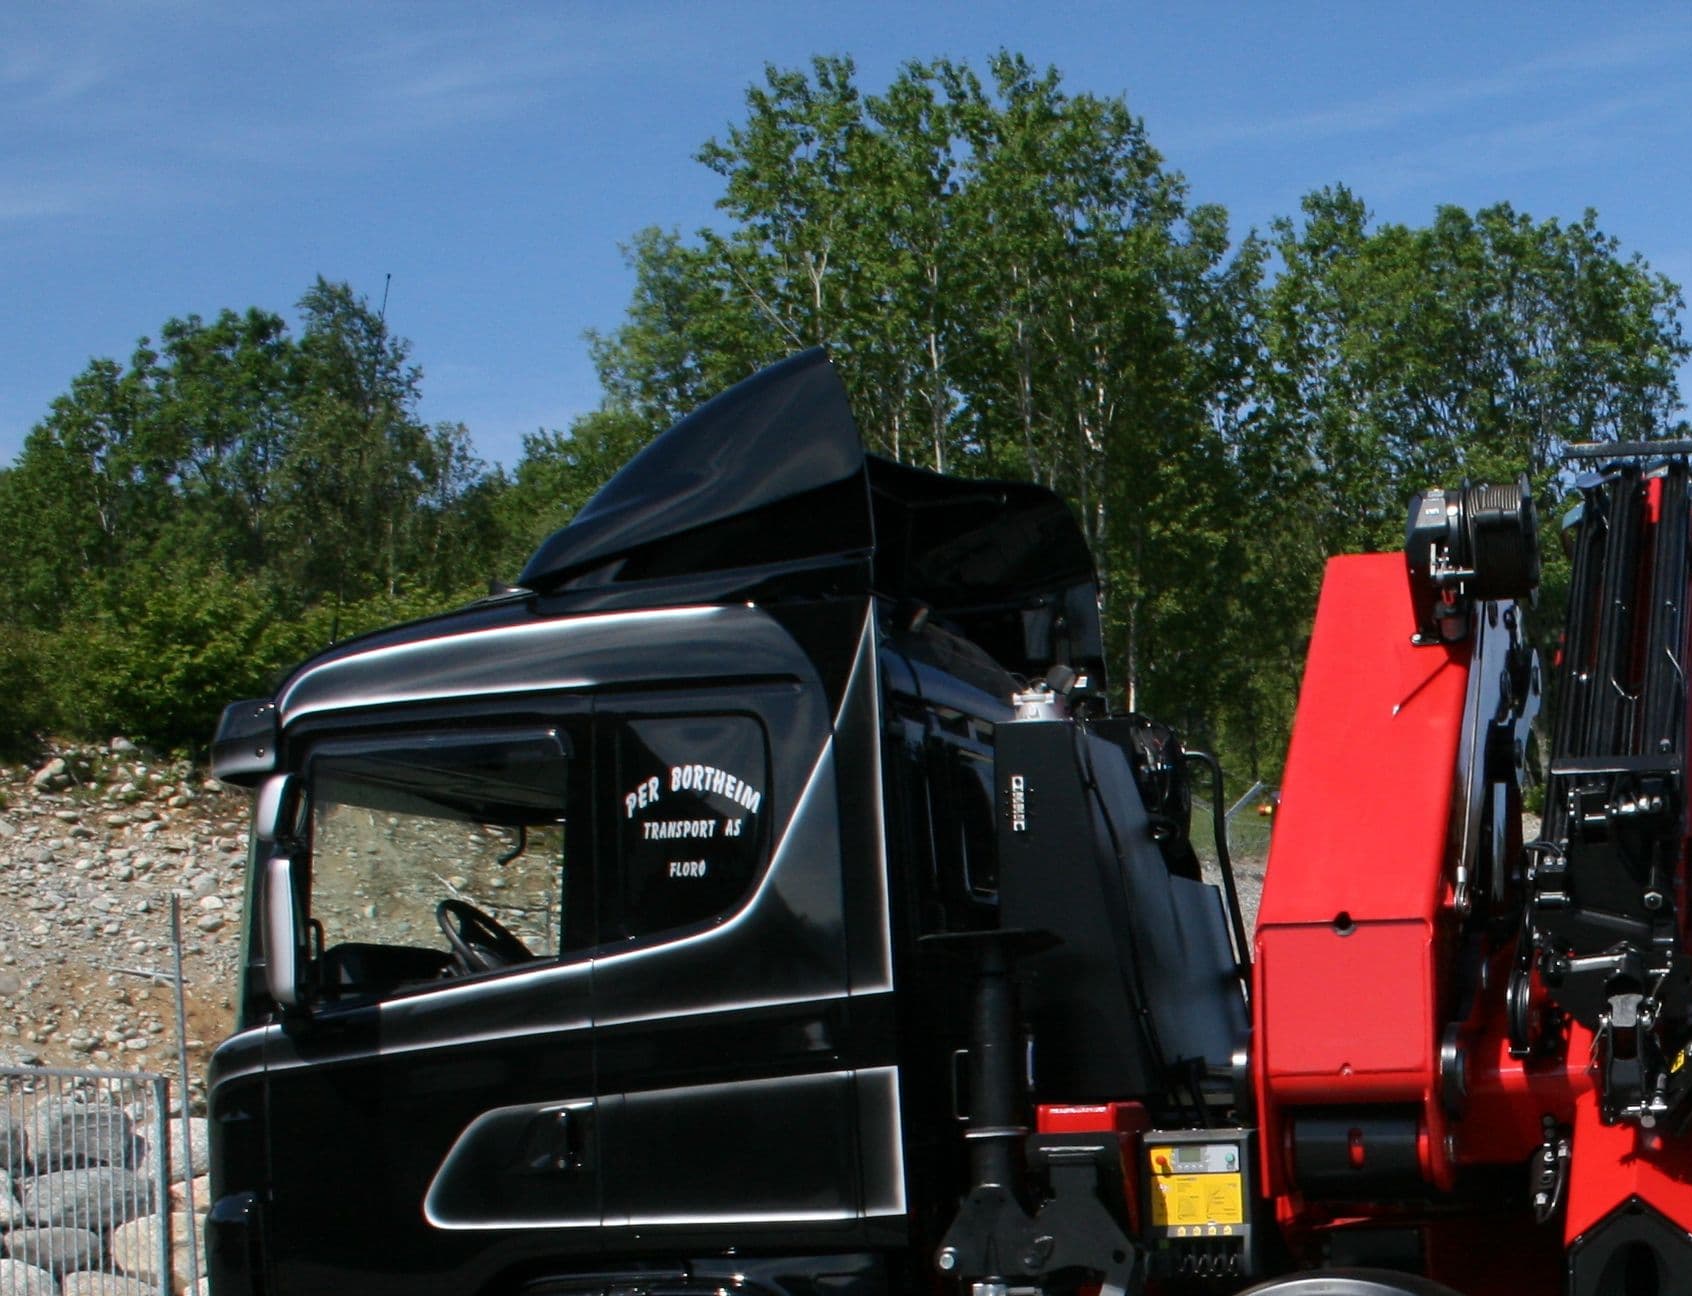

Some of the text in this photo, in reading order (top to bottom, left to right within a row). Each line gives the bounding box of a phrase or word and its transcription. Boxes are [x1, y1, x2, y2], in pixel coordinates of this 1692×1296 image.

[625, 764, 761, 818] PER BORTHEIM
[643, 818, 742, 840] TRANSPORT AS
